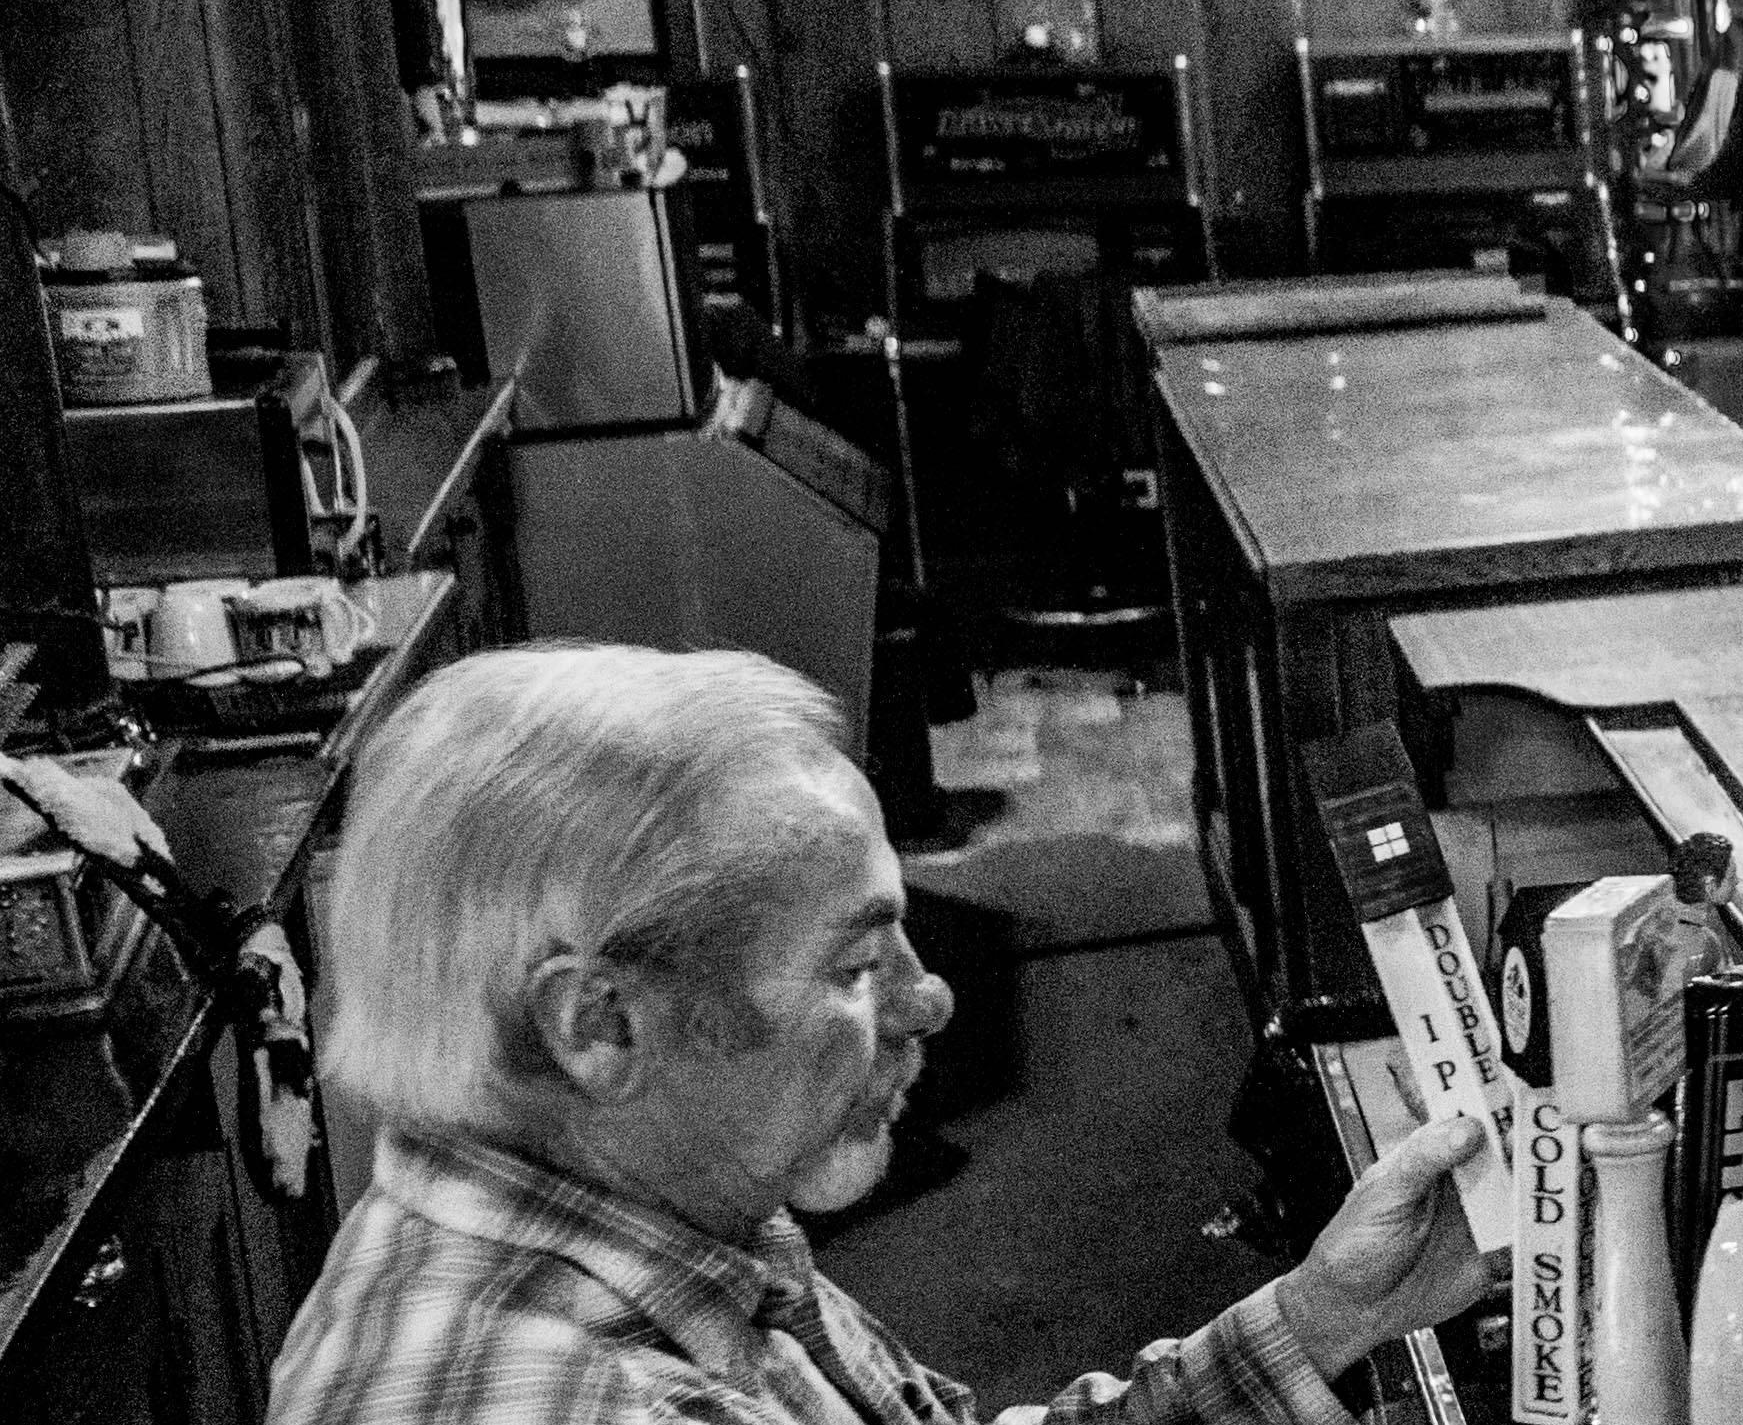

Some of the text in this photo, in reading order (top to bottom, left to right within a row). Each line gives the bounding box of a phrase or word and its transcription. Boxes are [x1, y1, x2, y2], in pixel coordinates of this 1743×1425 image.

[1418, 1012, 1467, 1118] IP
[1424, 923, 1504, 1086] DOUBLE
[1530, 1103, 1565, 1403] COLD SMOKE
